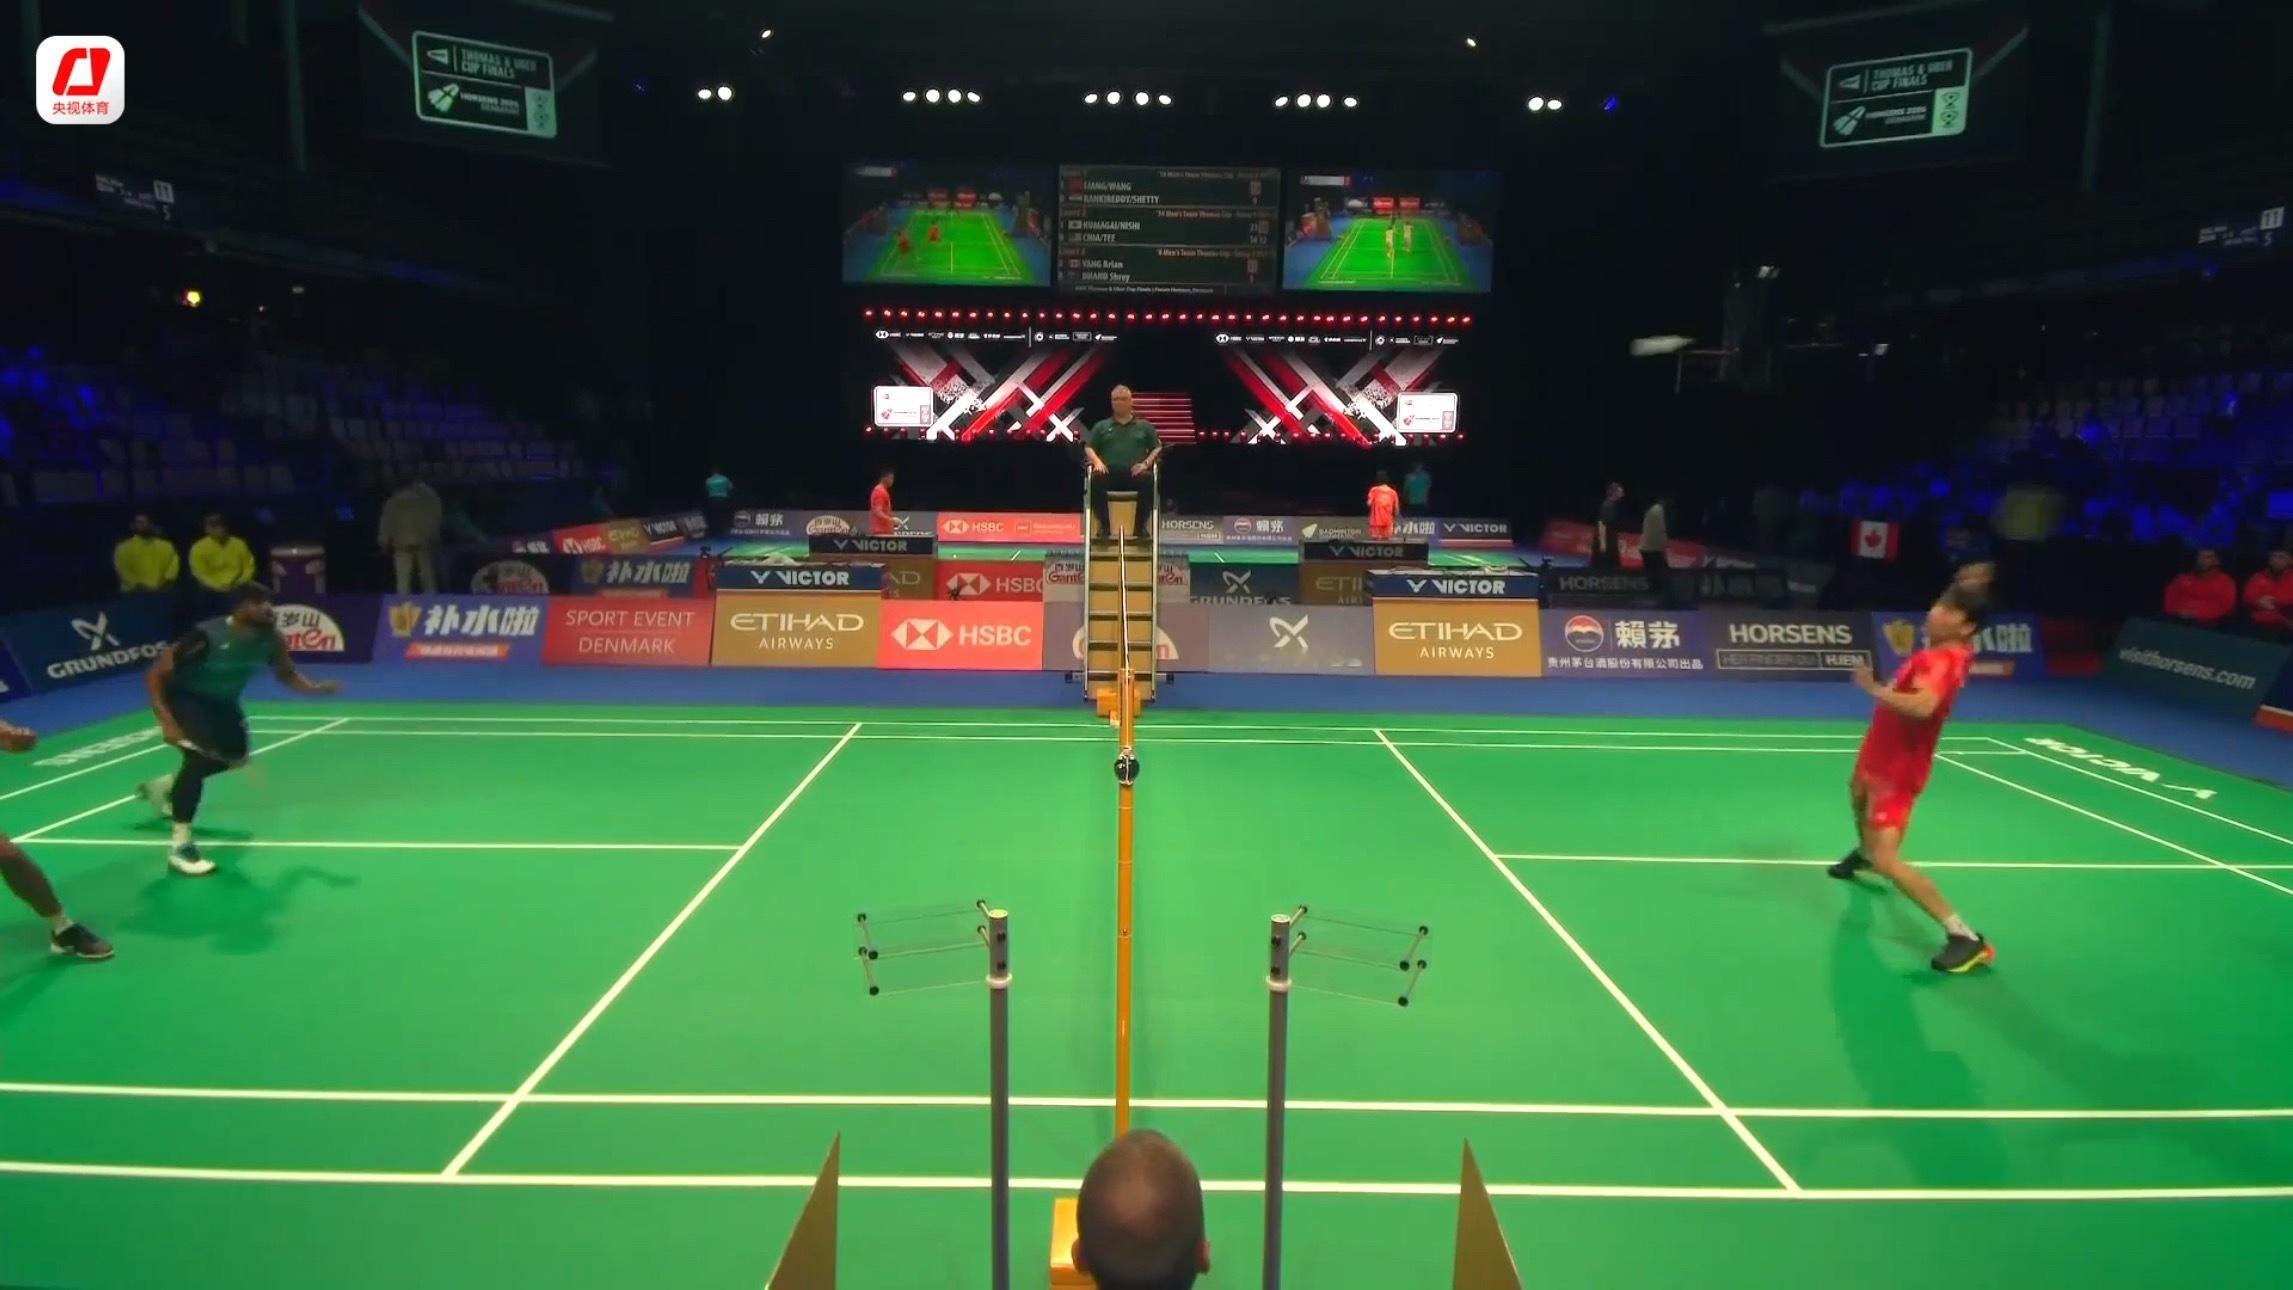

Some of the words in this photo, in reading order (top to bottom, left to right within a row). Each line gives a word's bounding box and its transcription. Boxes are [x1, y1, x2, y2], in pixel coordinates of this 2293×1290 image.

[461, 62, 481, 75] CUP
[483, 65, 516, 79] FINALS
[1893, 74, 1929, 89] FINALS
[1083, 220, 1141, 230] KUMAGAI/NISHI
[1083, 260, 1102, 268] YANG
[971, 523, 1004, 532] HSBC
[1161, 520, 1215, 530] HORSENS
[1459, 522, 1508, 533] VICTOR
[853, 539, 908, 552] VICTOR
[1349, 545, 1404, 558] VICTOR
[779, 570, 850, 587] VICTOR
[1432, 580, 1506, 594] VICTOR
[423, 604, 541, 636] 补水啦
[565, 609, 629, 627] SPORT
[633, 610, 696, 627] EVENT
[730, 613, 865, 632] ETIHAD
[959, 625, 1032, 646] HSBC
[1388, 621, 1523, 641] ETIHAD
[1729, 623, 1853, 644] HORSENS
[578, 636, 677, 654] DENMARK
[759, 637, 835, 651] AIRWAYS
[1419, 646, 1495, 660] AIRWAYS
[1824, 654, 1864, 666] HJEM
[2119, 646, 2256, 690] visithorsens.com
